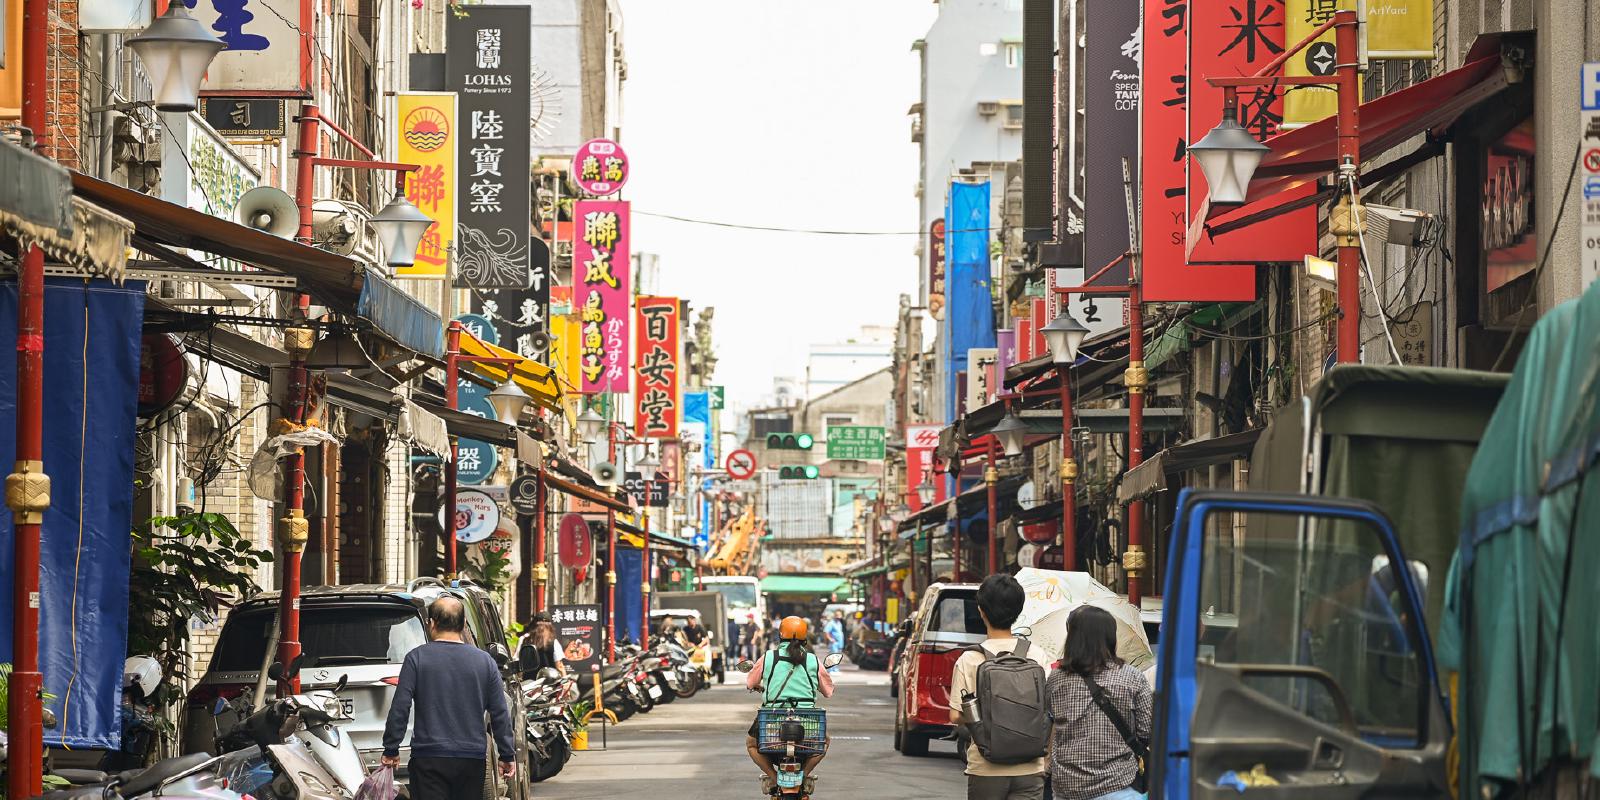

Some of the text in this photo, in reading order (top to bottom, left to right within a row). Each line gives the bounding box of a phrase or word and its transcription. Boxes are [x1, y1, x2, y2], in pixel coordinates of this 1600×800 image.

[1368, 6, 1407, 15] ArtYard
[464, 74, 512, 85] LOHAS
[469, 110, 504, 213] 陸寶窯
[606, 317, 624, 380] からすみ
[639, 304, 675, 431] 百安堂
[457, 448, 482, 471] 器
[456, 494, 485, 503] Monkey
[474, 504, 491, 512] Mars
